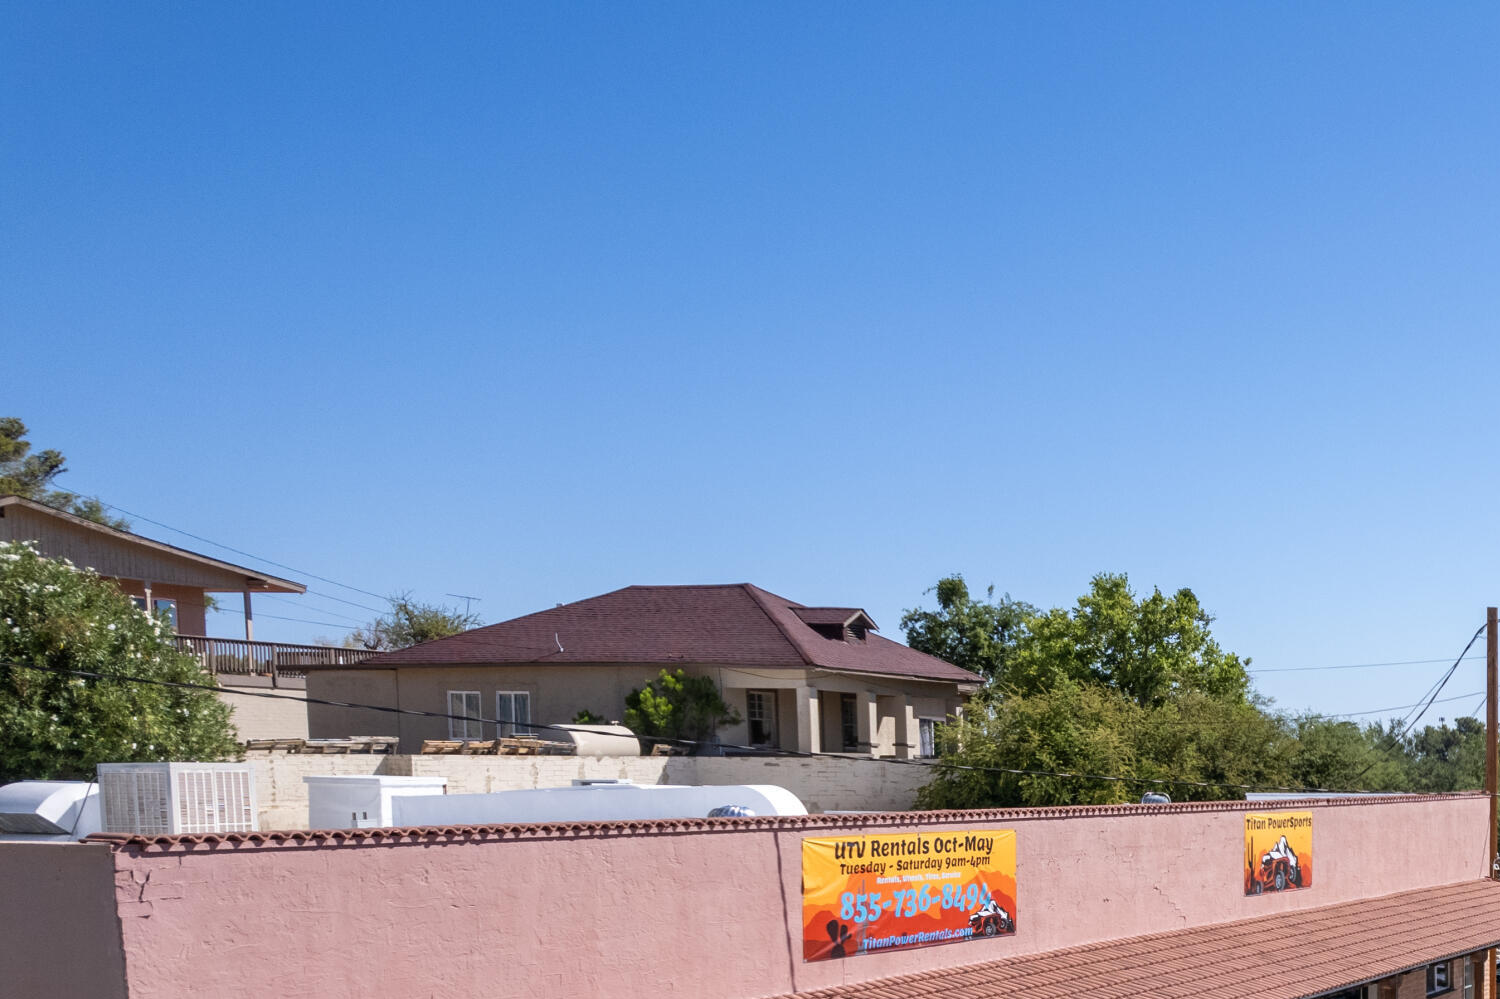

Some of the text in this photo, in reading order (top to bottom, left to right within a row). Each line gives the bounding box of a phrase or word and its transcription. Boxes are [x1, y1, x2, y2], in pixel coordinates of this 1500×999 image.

[1246, 816, 1312, 830] Titan PowerSports
[834, 835, 994, 859] UTV Rentals Oct-May
[840, 861, 886, 875] Tuesday
[897, 857, 942, 872] Saturday
[945, 855, 991, 868] 9am-4pm
[840, 882, 992, 923] 855-736-8494
[862, 926, 973, 949] TitanPowerRentals.com
